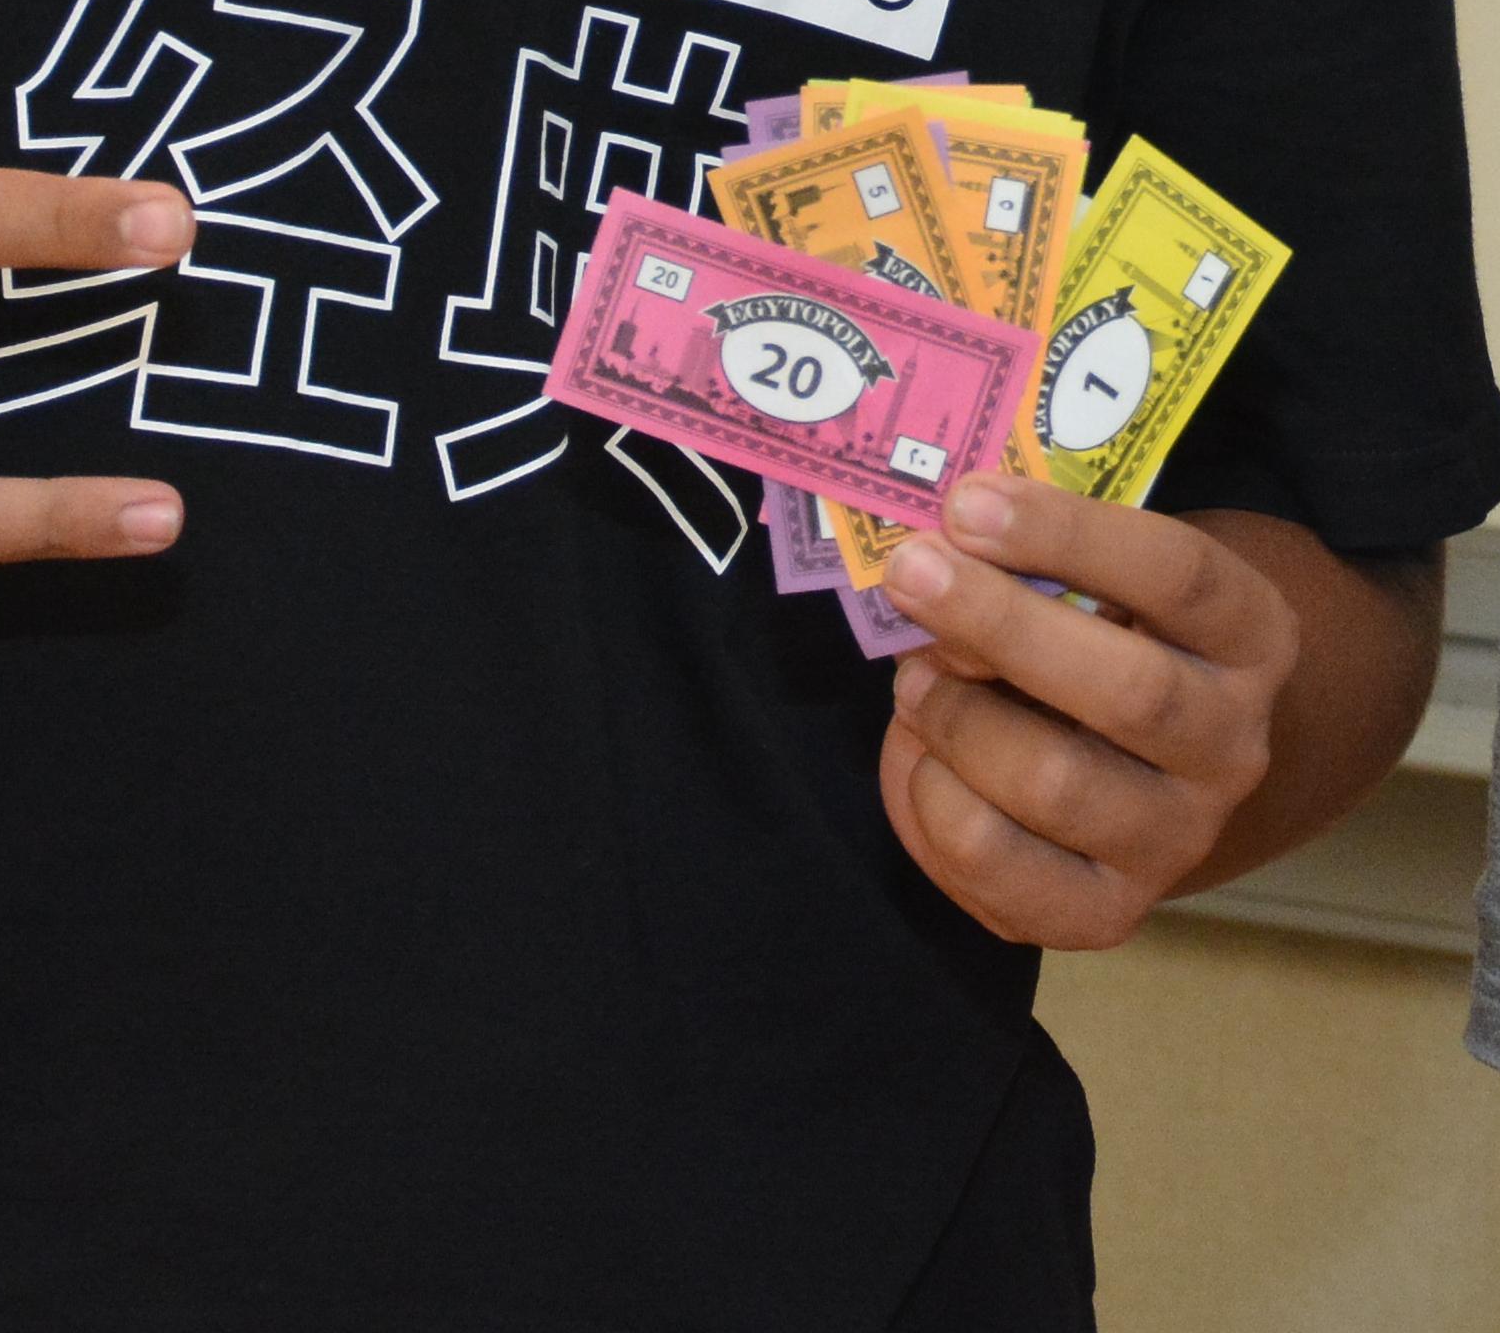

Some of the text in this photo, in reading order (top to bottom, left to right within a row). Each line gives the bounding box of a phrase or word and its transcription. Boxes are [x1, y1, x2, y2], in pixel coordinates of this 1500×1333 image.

[650, 265, 679, 289] 20
[724, 297, 880, 376] EGYTOPOLY
[749, 342, 823, 400] 20
[1083, 371, 1119, 401] 1
